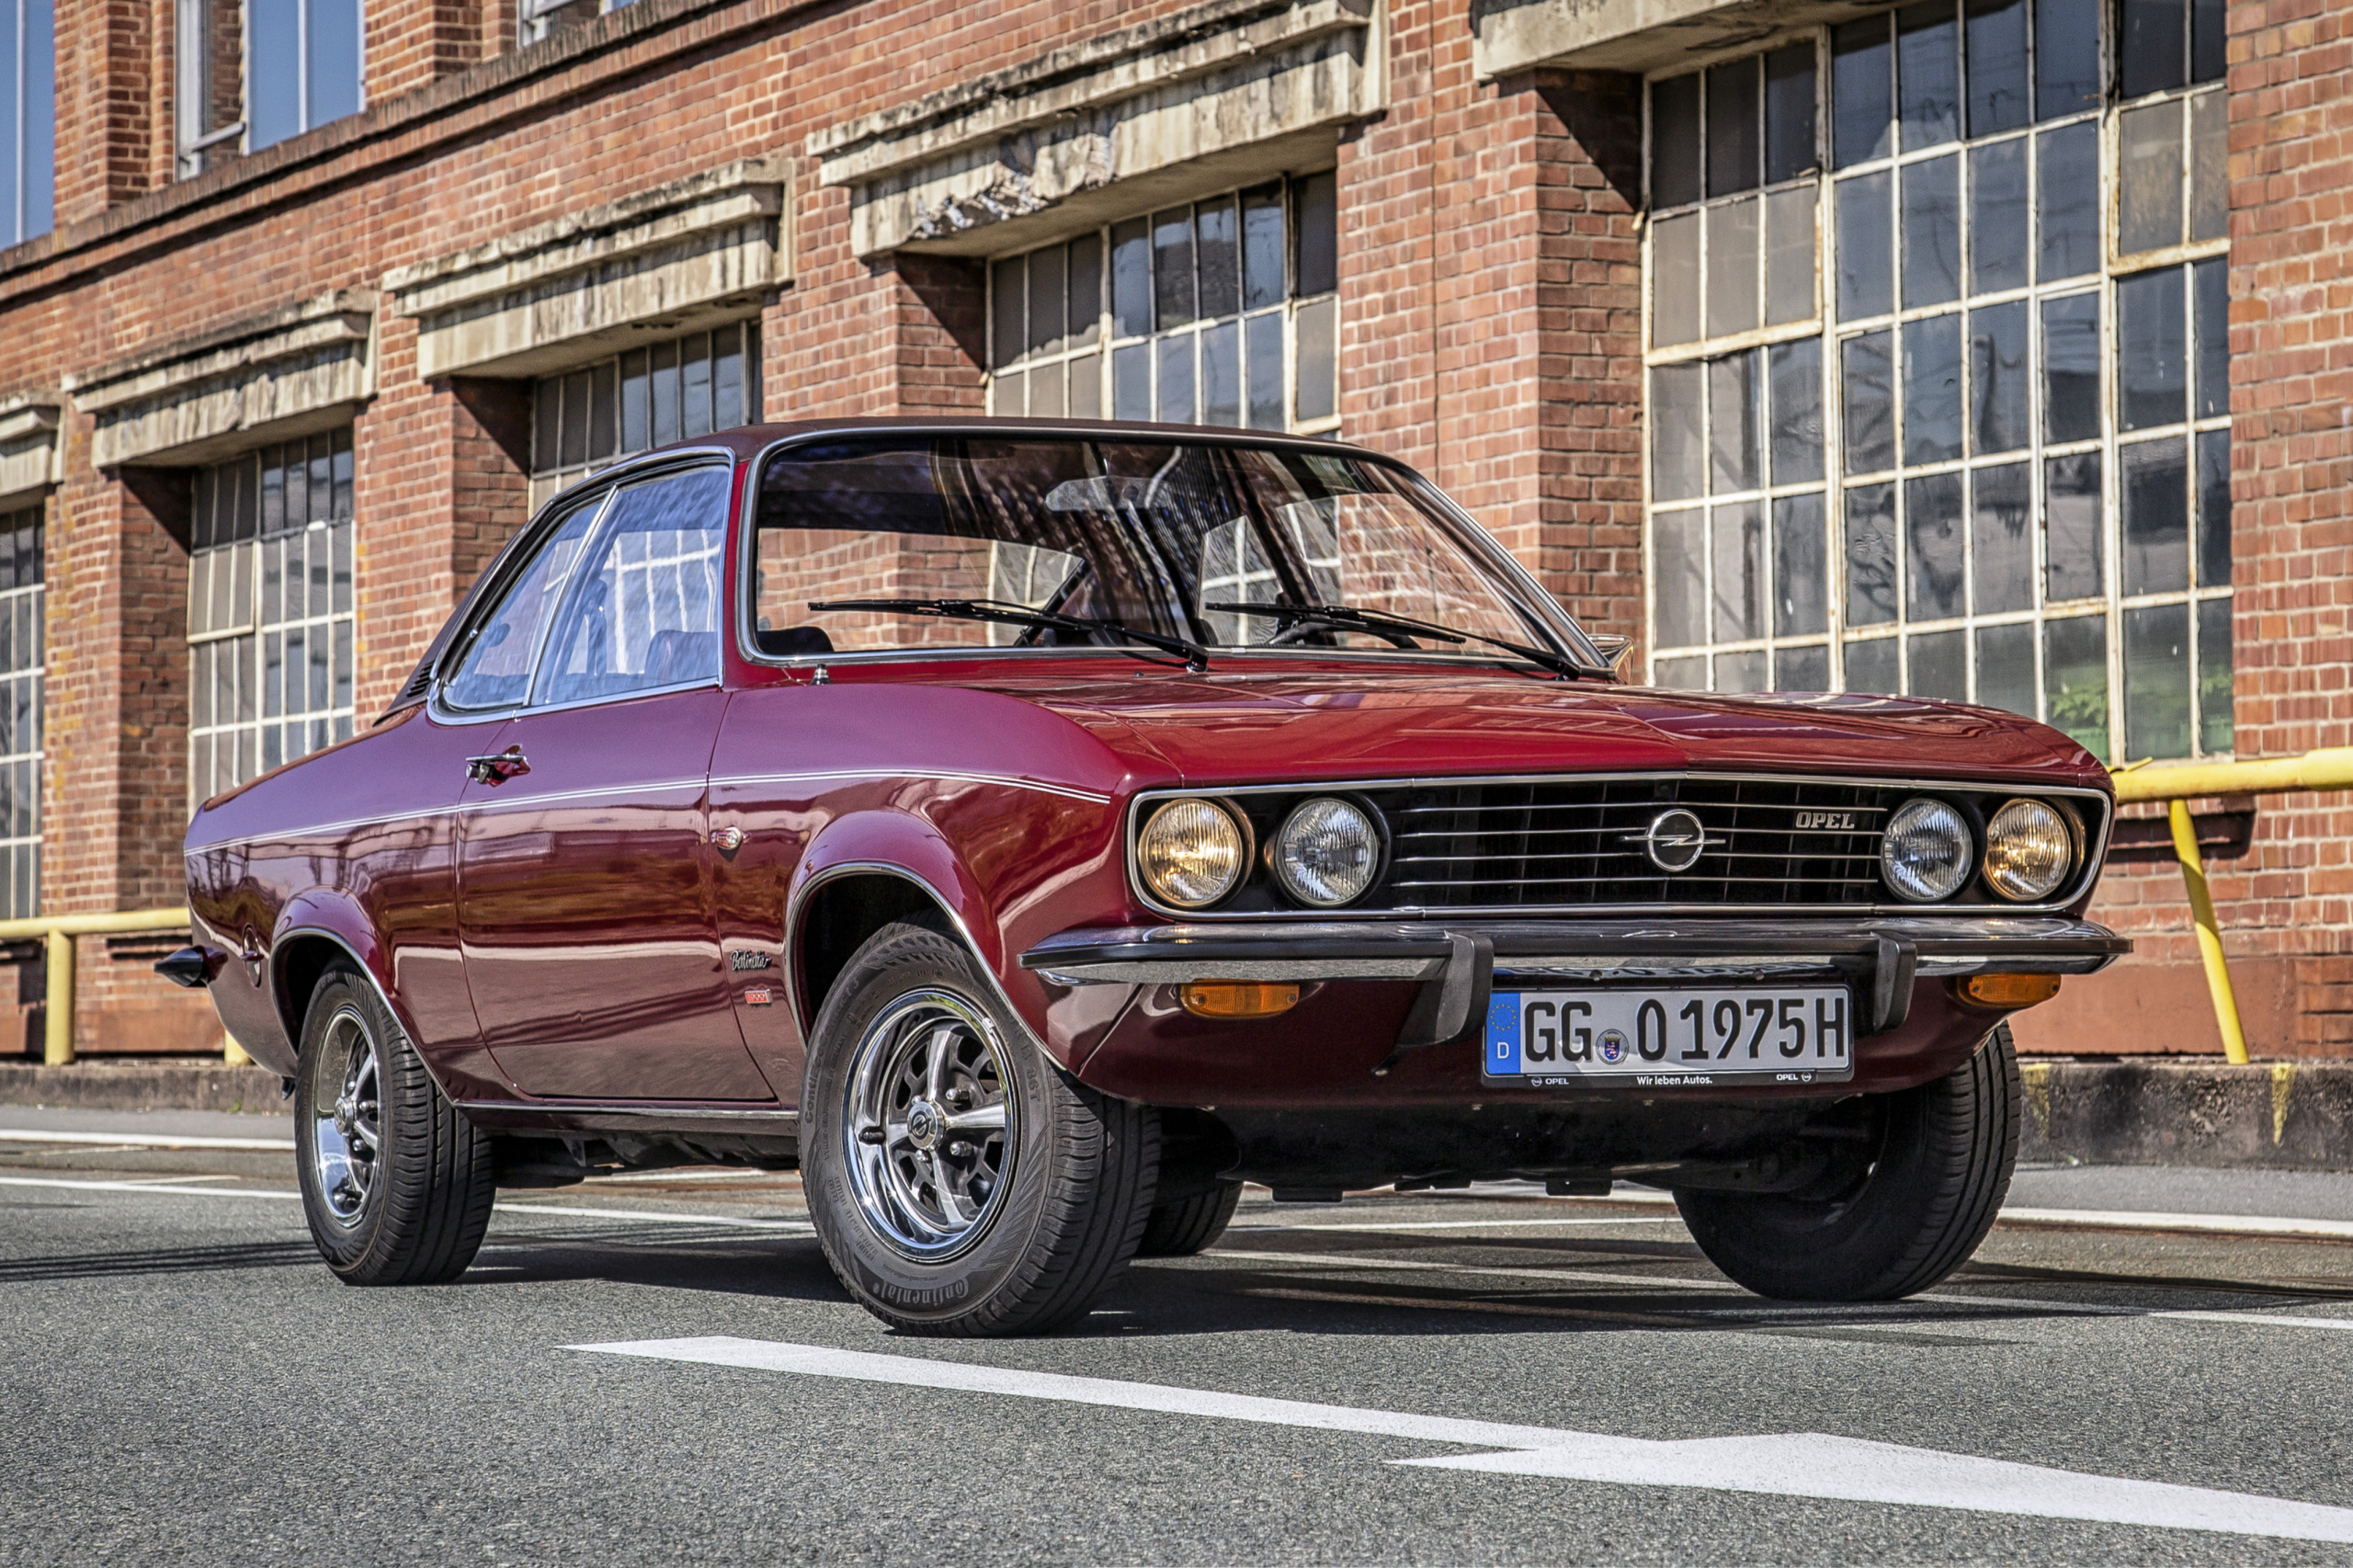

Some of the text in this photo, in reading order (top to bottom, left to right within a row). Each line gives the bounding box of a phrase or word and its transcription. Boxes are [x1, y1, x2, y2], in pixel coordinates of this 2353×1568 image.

[1795, 812, 1855, 829] OPEL
[1524, 1001, 1593, 1062] GG
[1679, 997, 1846, 1061] 1975H
[1496, 1041, 1510, 1060] D
[1545, 1077, 1570, 1086] OPEL
[1637, 1074, 1713, 1085] Wir leben Autos.
[1776, 1073, 1799, 1082] OPEL
[881, 1278, 969, 1306] Continental
